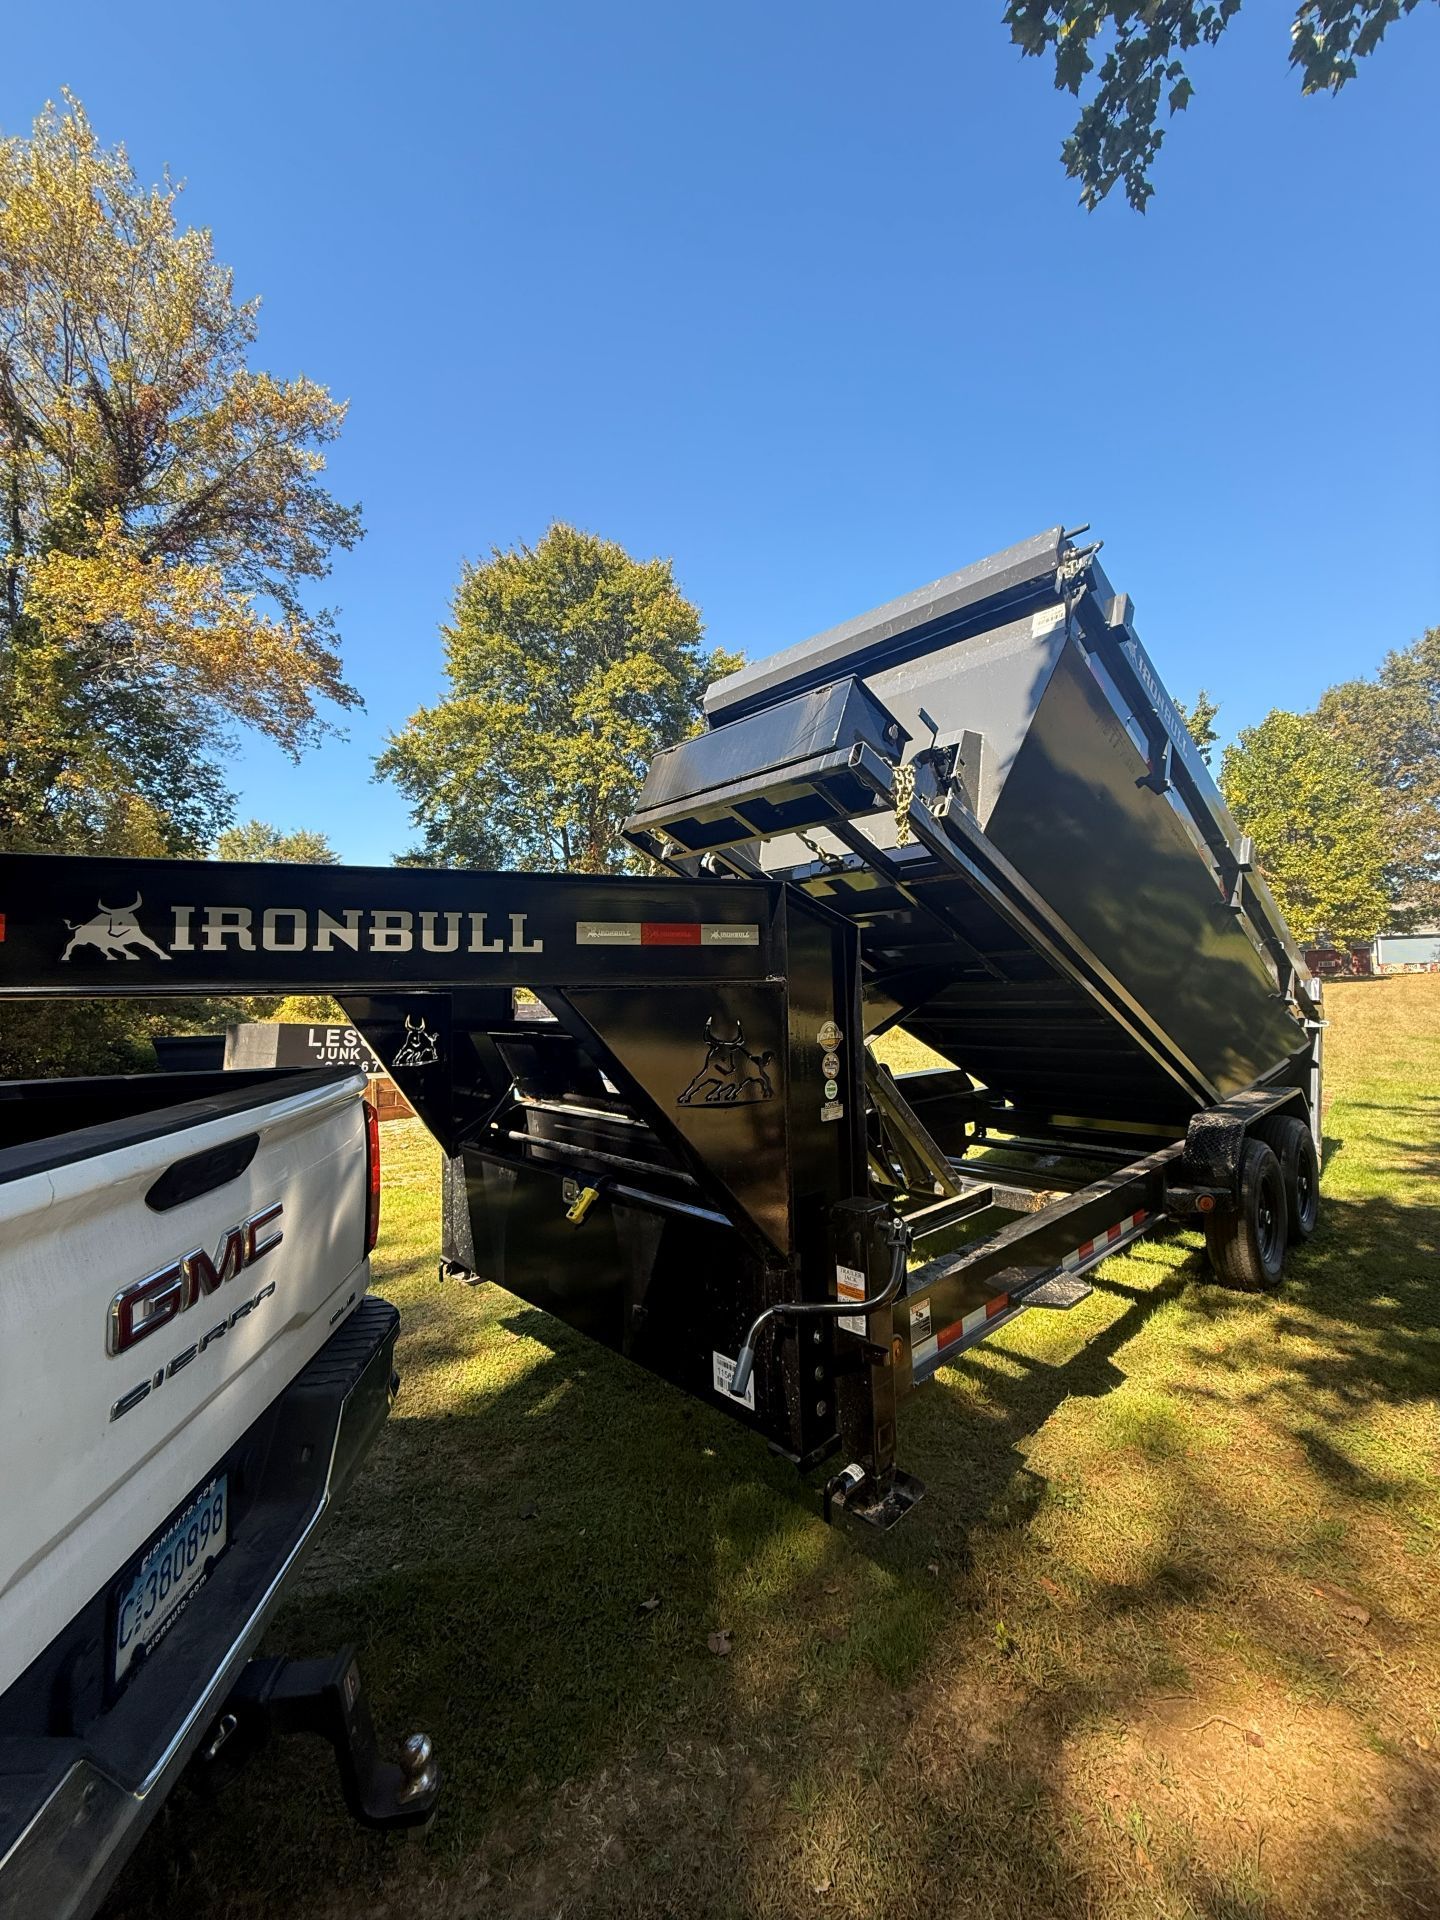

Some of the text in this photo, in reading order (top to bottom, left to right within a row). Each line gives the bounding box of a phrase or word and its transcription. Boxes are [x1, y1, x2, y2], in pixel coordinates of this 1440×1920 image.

[1137, 654, 1188, 759] IRONBULL
[170, 906, 543, 953] IRONBULL
[316, 1048, 360, 1060] JUNK
[106, 1201, 283, 1358] GMC
[110, 1281, 276, 1423] SIERRA
